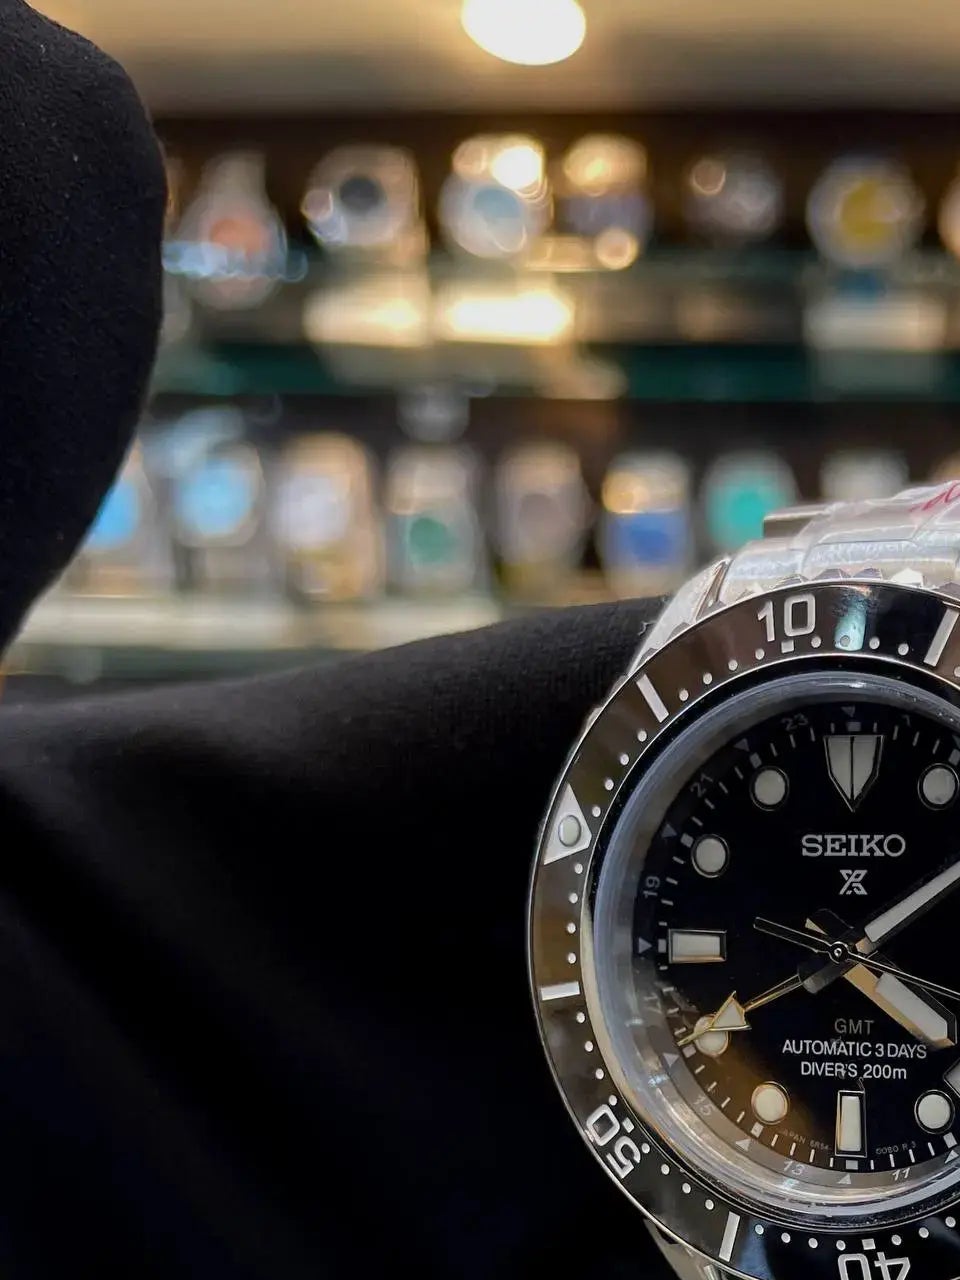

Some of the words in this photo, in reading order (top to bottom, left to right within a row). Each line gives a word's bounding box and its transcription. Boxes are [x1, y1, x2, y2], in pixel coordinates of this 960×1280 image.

[756, 593, 816, 642] 10
[801, 834, 906, 858] SEIKO
[642, 875, 660, 899] 19
[835, 1018, 874, 1035] GMT
[782, 1040, 871, 1057] AUTOMATIC
[875, 1042, 884, 1057] 3
[888, 1043, 927, 1059] DAYS
[801, 1061, 858, 1079] DIVER'S
[863, 1064, 907, 1080] 200m
[586, 1104, 642, 1179] 50
[783, 1159, 806, 1175] 13
